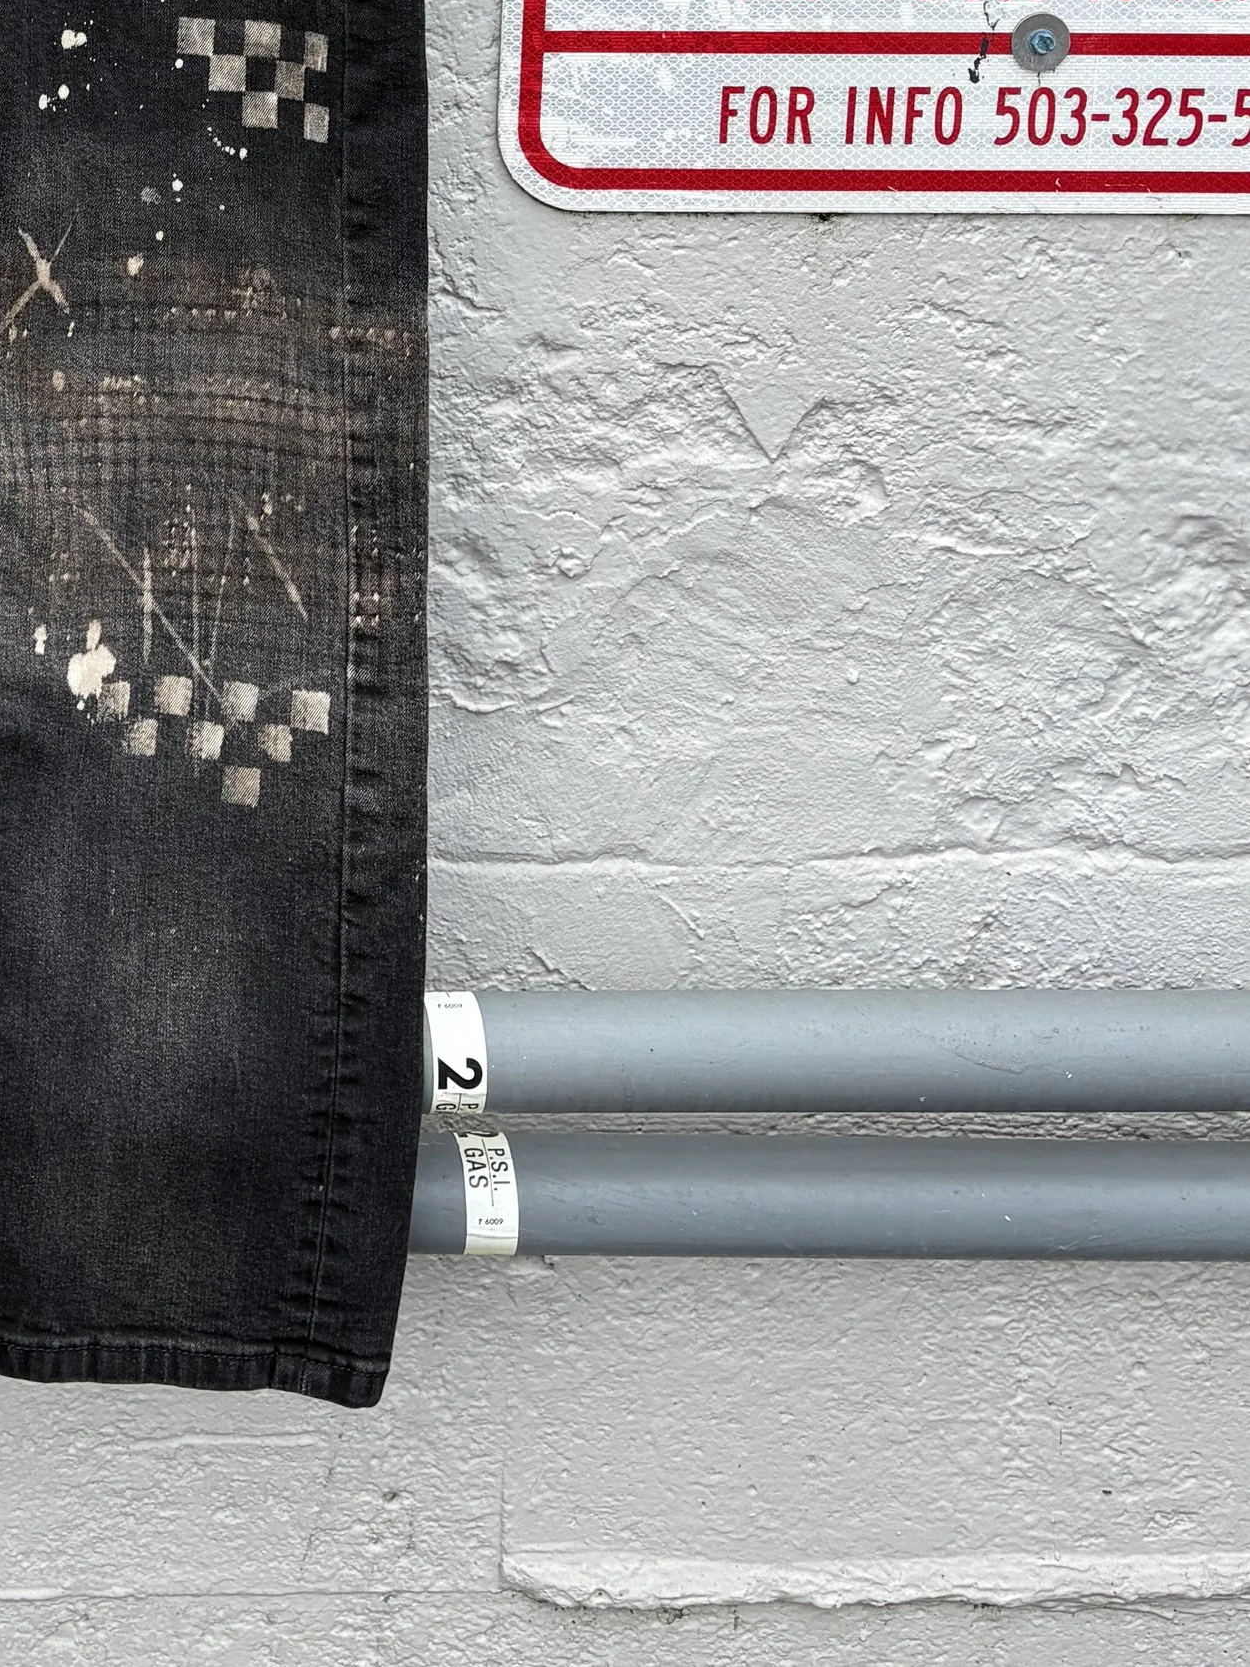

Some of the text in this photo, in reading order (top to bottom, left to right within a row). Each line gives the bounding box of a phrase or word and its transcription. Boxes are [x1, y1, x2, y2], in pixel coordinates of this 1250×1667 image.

[718, 85, 1250, 148] FOR INFO 503-325-5
[436, 1056, 483, 1090] 2
[463, 1147, 489, 1189] GAS
[487, 1147, 511, 1191] P.S.I.
[484, 1218, 504, 1226] 6009
